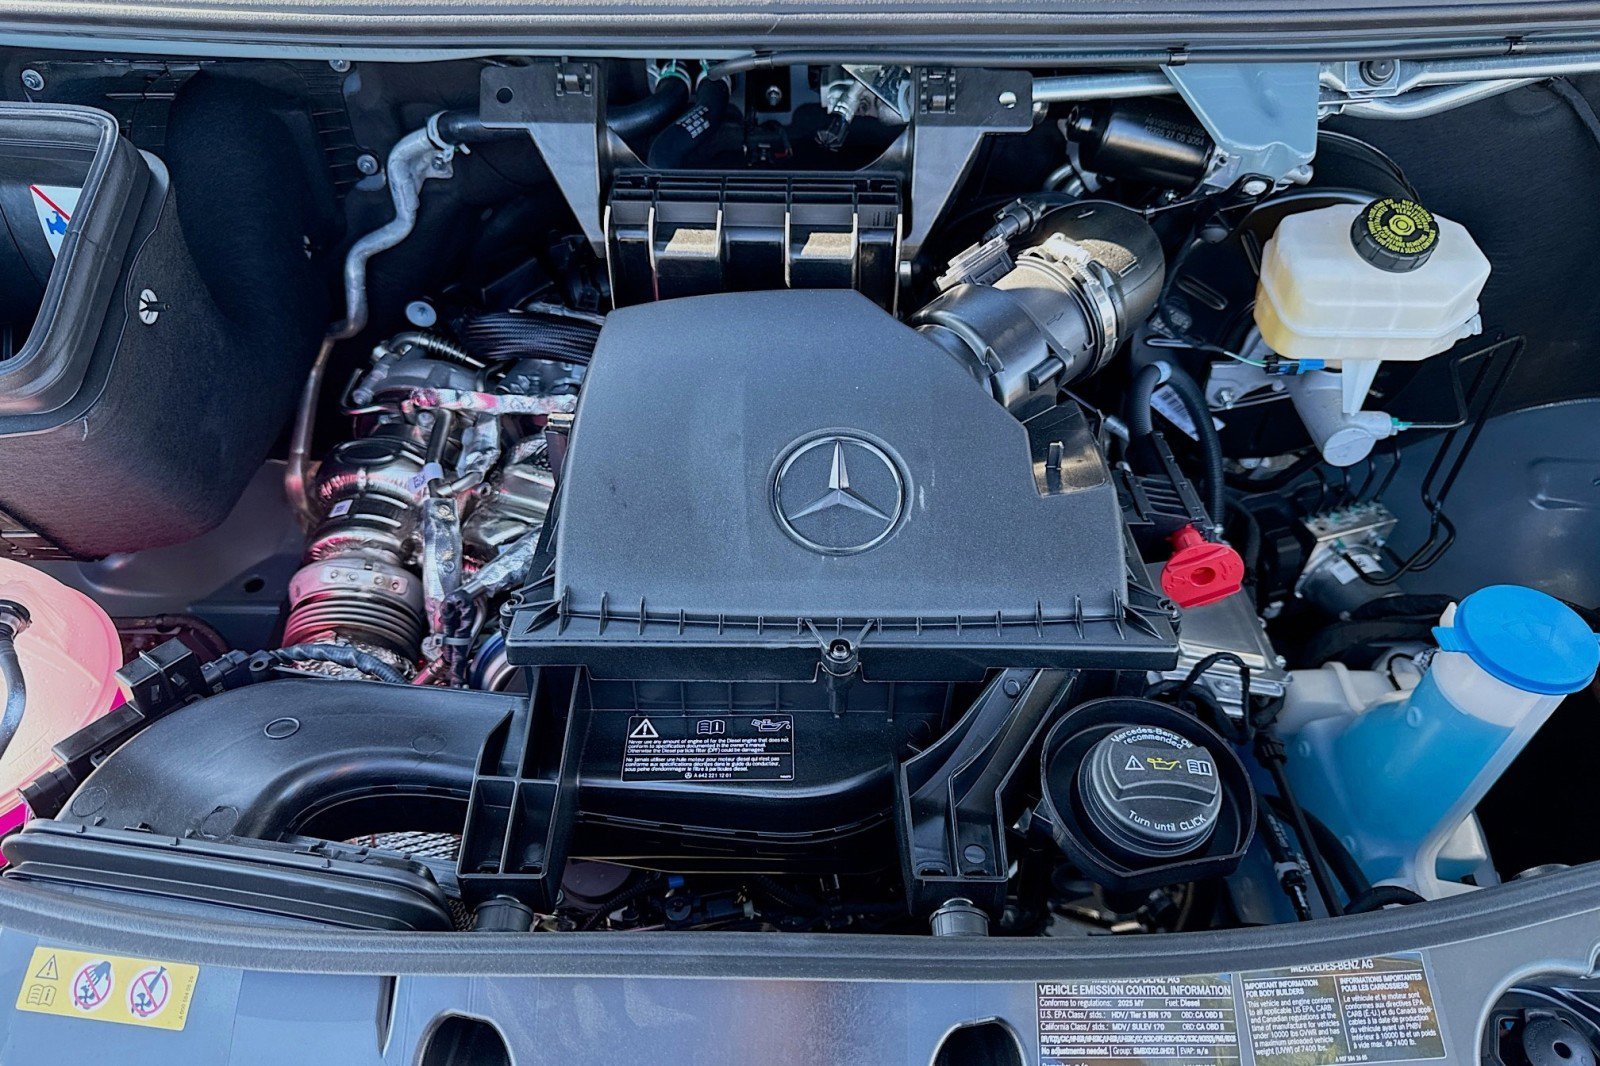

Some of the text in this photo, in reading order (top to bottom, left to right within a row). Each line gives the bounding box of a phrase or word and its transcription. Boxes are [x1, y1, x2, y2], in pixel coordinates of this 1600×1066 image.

[1110, 726, 1193, 749] Mercedes-Benz Oil
[1122, 732, 1183, 750] recommended
[1128, 809, 1207, 832] Turn until CLICK
[1362, 959, 1374, 969] AG
[1340, 973, 1422, 985] INFORMATIONS IMPORTANTES
[1039, 984, 1231, 995] VEHICLE EMISSION CONTROL INFORMATION
[1244, 979, 1319, 990] IMPORTANT INFORMATION
[1341, 984, 1358, 992] POUR
[1369, 982, 1409, 991] CARROSSIERS
[1246, 990, 1258, 998] FOR
[1276, 988, 1305, 996] BUILDERS
[1039, 999, 1069, 1007] Conforms
[1180, 999, 1200, 1007] Diesel
[1040, 1011, 1053, 1019] U.S.
[1264, 1007, 1292, 1016] applicable
[1288, 1014, 1320, 1023] regulations
[1040, 1022, 1070, 1031] California
[1272, 1022, 1307, 1030] manufacture
[1271, 1030, 1289, 1038] 10000
[1041, 1047, 1050, 1055] No
[1051, 1046, 1086, 1057] adjustments
[1255, 1048, 1275, 1057] weight
[1301, 1044, 1316, 1052] 7400
